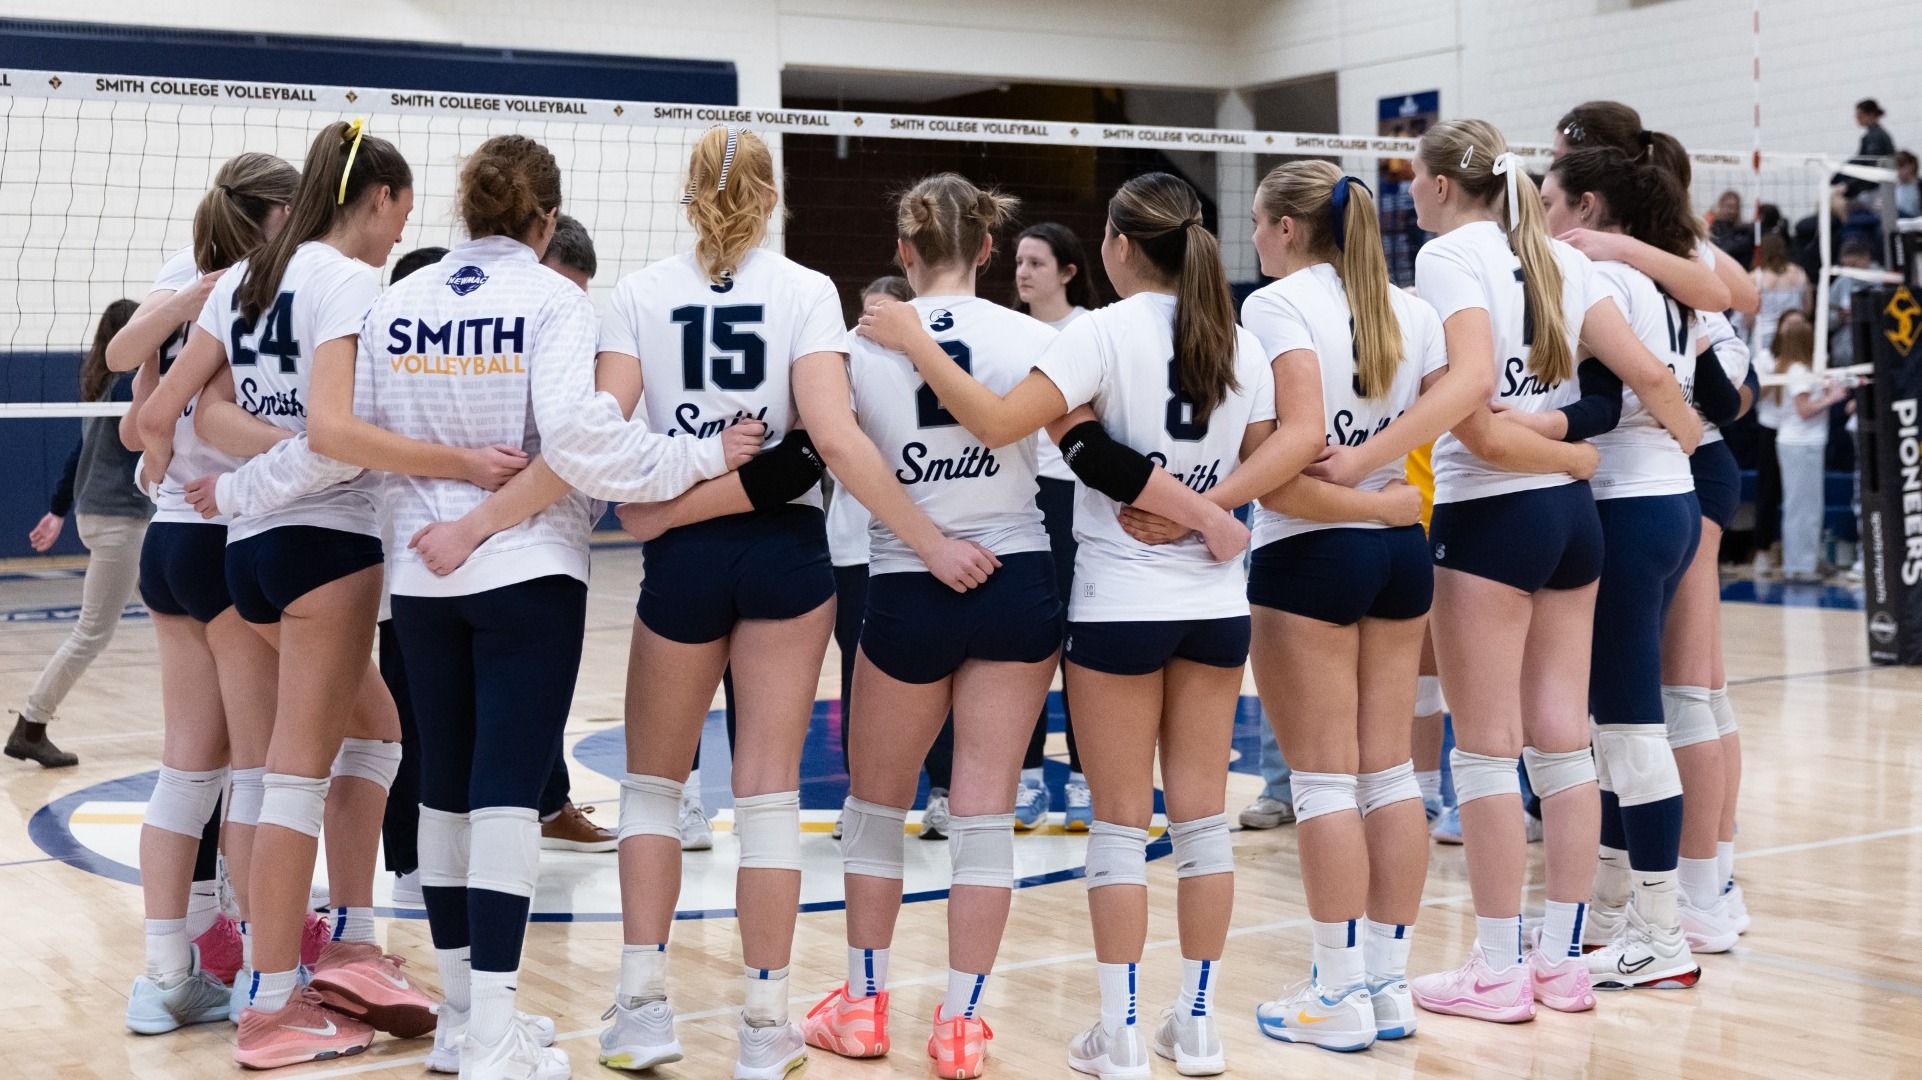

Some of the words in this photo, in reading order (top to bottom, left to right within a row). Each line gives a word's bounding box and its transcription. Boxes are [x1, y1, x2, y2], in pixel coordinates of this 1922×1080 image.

[95, 78, 144, 93] SMITH
[150, 81, 219, 97] COLLEGE
[224, 84, 317, 102] VOLLEYBALL
[390, 93, 434, 108] SMITH
[439, 96, 500, 111] COLLEGE
[504, 99, 588, 115] VOLLEYBALL
[653, 107, 693, 120] SMITH
[697, 109, 752, 123] COLLEGE
[756, 112, 830, 126] VOLLEYBALL
[890, 118, 924, 131] SMITH
[928, 120, 978, 133] COLLEGE
[982, 123, 1049, 137] VOLLEYBALL
[1102, 129, 1134, 140] SMITH
[1138, 130, 1183, 142] COLLEGE
[1186, 133, 1246, 145] VOLLEYBALL
[447, 275, 489, 286] NEWMAC
[230, 289, 302, 375] 24
[386, 316, 526, 356] SMITH
[670, 303, 767, 393] 15
[391, 355, 526, 376] VOLLEYBALL
[895, 441, 1001, 485] Smith
[1891, 398, 1922, 588] PIONEERS
